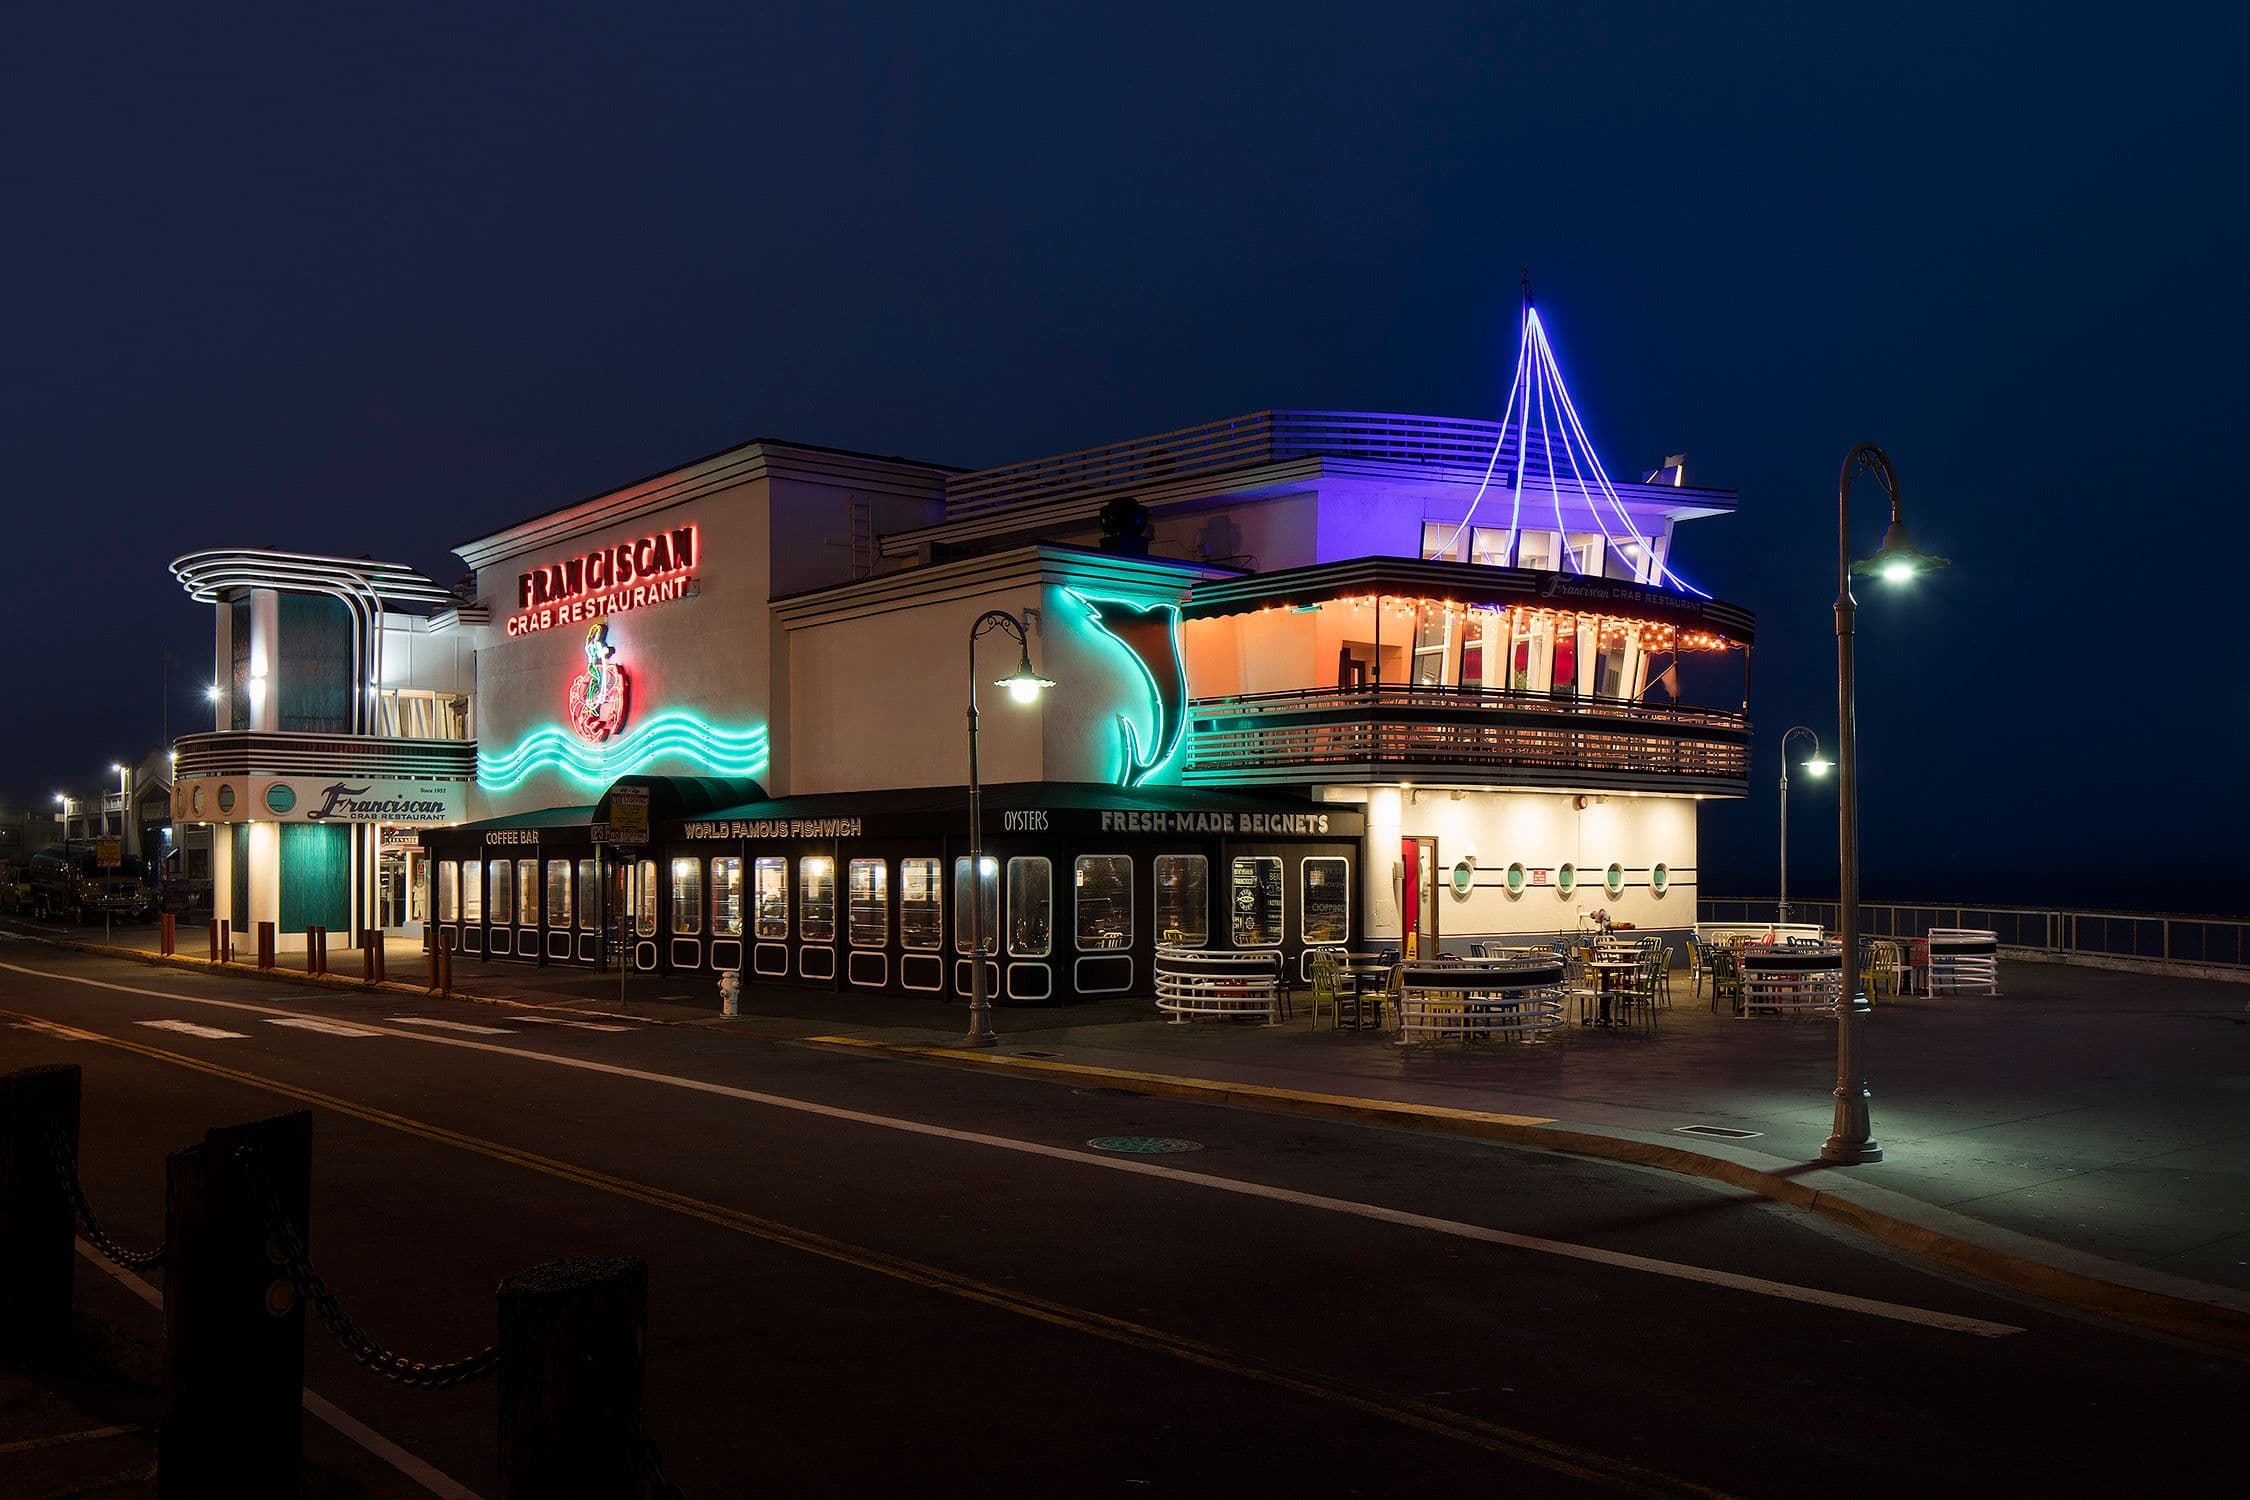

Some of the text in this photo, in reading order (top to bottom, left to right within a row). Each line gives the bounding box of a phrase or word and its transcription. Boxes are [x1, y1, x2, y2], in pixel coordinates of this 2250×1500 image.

[518, 527, 696, 609] FRANCISCAN
[1541, 574, 1700, 612] Franciscan CRAB RESTAURANT
[507, 576, 690, 637] CRAB RESTAURANT
[307, 781, 445, 820] Franciscan
[381, 813, 446, 821] RESTAURANT
[684, 817, 862, 839] WORLD FAMOUS FISHWICH
[1004, 810, 1049, 831] OYSTERS
[1101, 811, 1329, 834] FRESH-MADE BEIGNETS
[486, 828, 540, 845] COFFEE BAR
